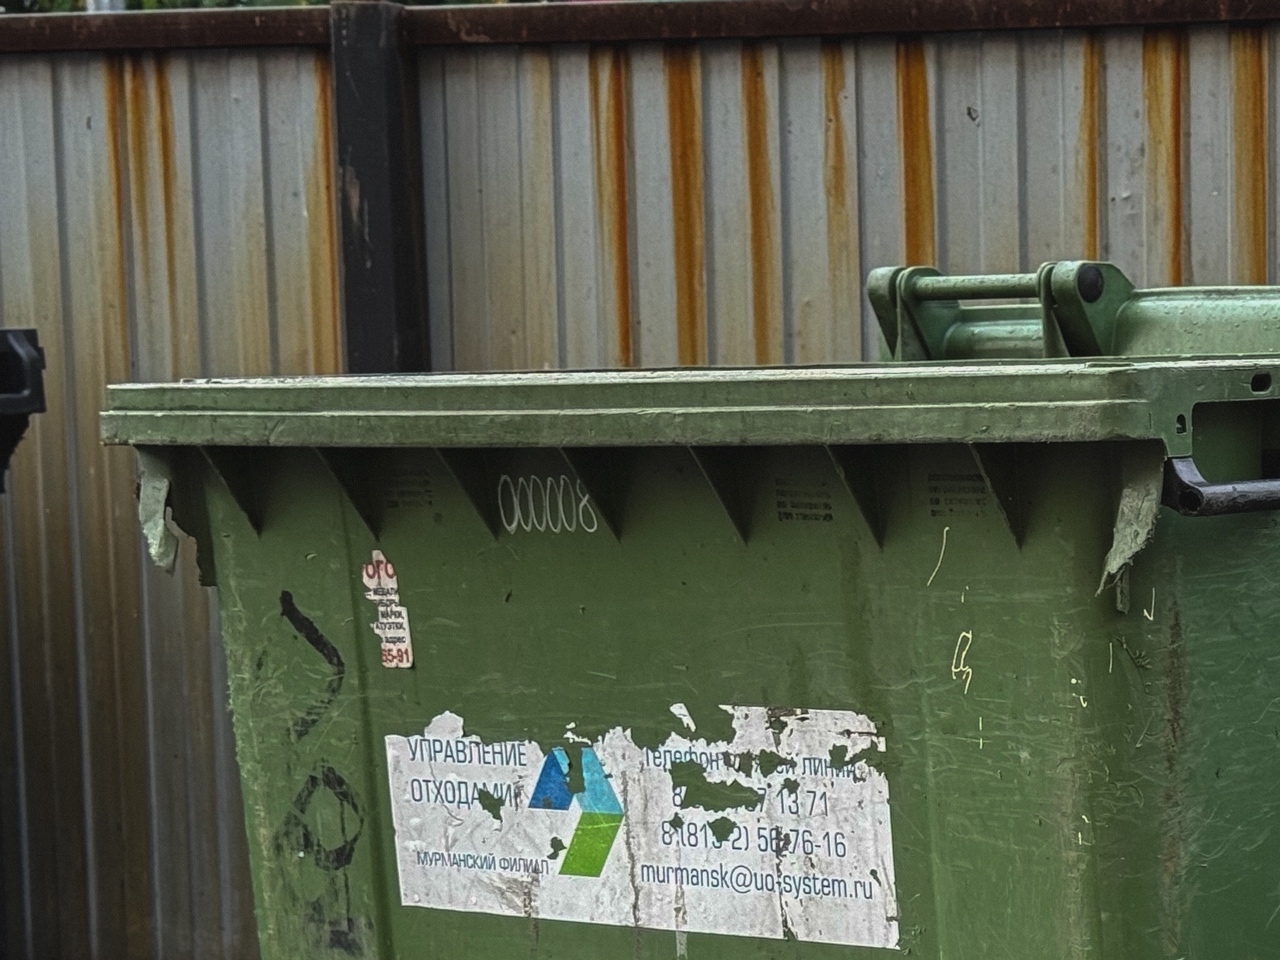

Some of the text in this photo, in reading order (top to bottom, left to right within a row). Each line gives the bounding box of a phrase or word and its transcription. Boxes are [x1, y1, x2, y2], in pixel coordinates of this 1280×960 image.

[407, 738, 527, 766] УПРАВЛЕНИЕ
[806, 790, 829, 817] 71
[416, 850, 550, 875] МУРМАНСКИЙ ФИЛИАЛ
